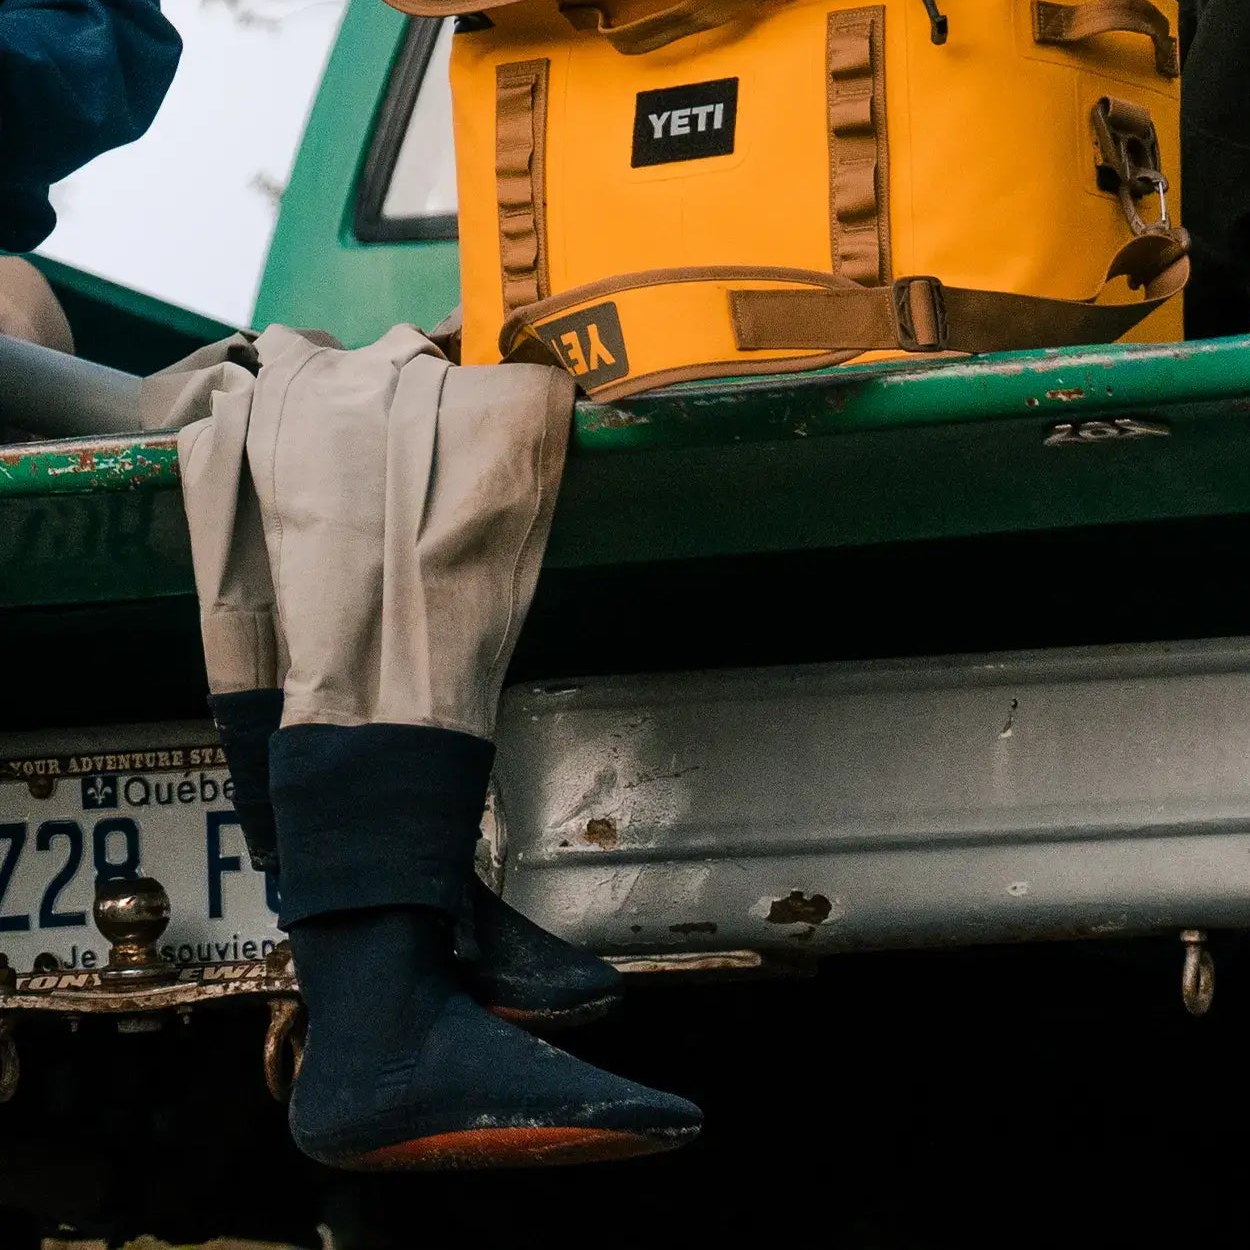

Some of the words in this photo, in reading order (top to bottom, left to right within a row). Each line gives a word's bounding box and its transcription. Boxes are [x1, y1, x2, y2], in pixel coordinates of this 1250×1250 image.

[648, 103, 724, 139] YETI
[552, 323, 616, 377] YE
[10, 759, 60, 777] YOUR
[67, 750, 184, 773] ADVENTURE
[189, 747, 227, 765] STA
[124, 770, 236, 807] Québe
[64, 945, 97, 969] Je
[160, 934, 276, 963] souvien
